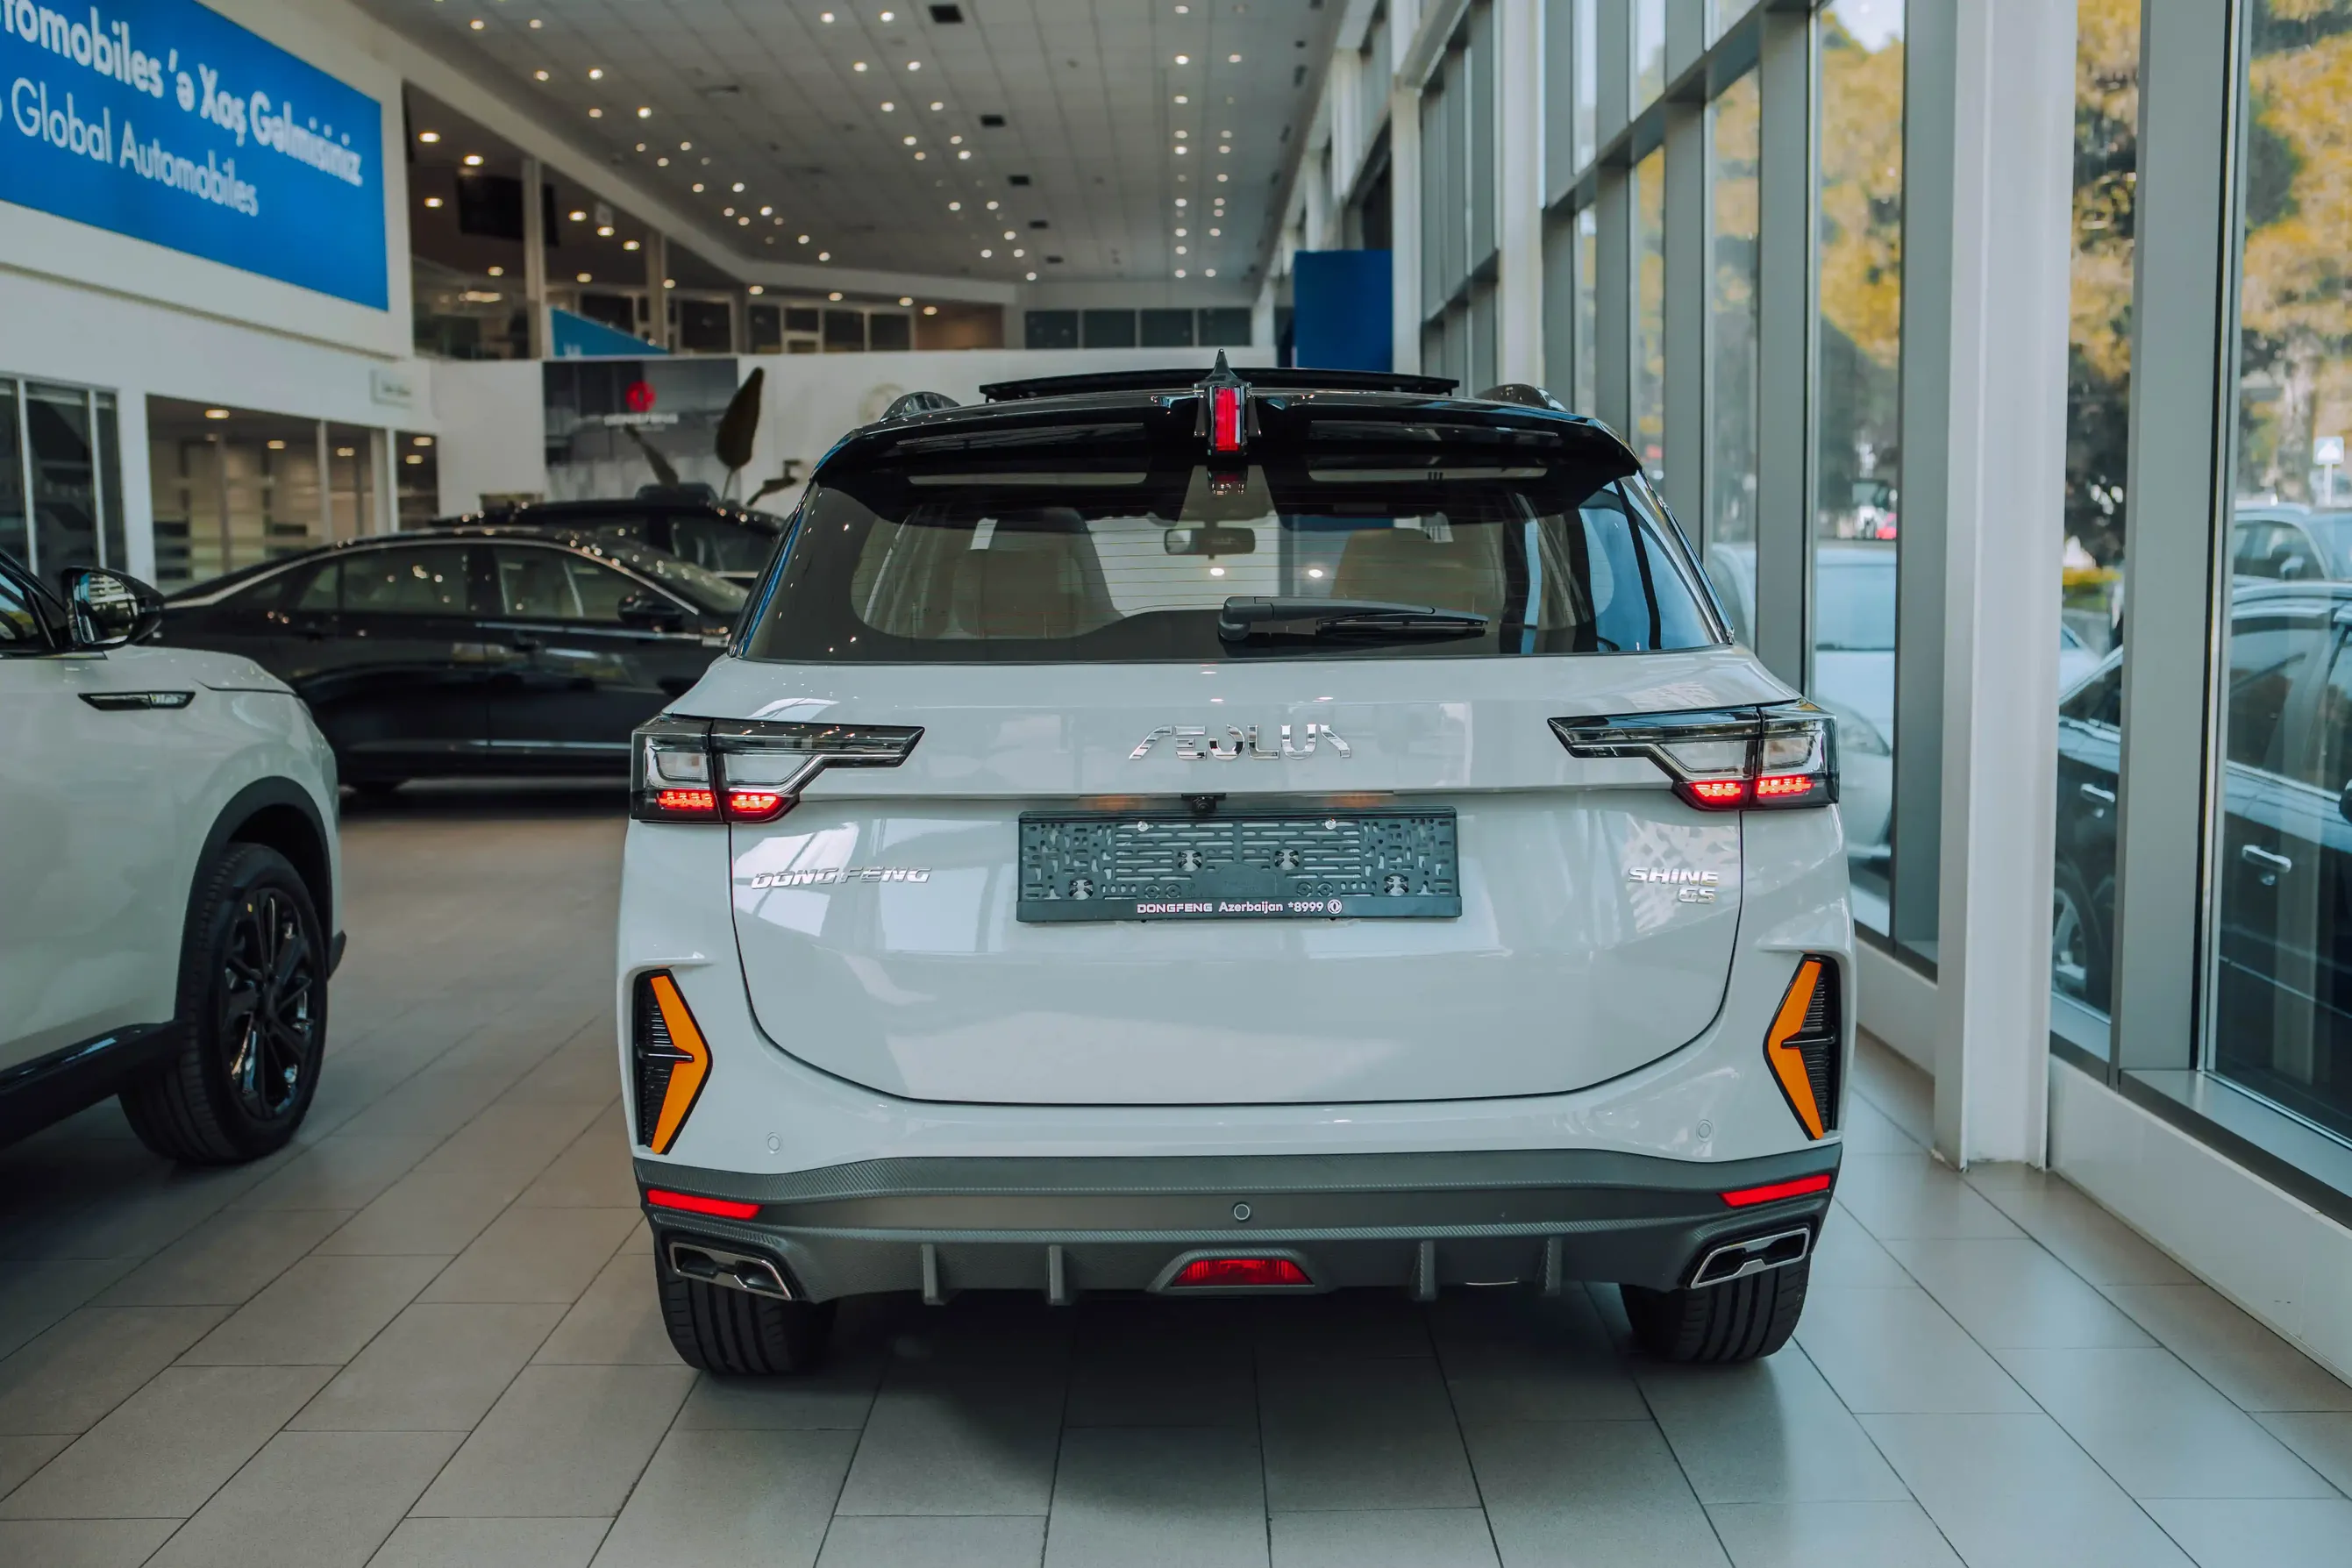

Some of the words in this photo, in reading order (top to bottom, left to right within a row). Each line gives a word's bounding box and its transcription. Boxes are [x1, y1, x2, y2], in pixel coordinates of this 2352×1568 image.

[0, 0, 164, 98] tomobiles
[11, 77, 112, 164] Global
[119, 120, 259, 217] Automobiles
[751, 866, 932, 889] DONGFENG
[1628, 866, 1719, 887] SHINE
[1678, 887, 1716, 904] GS
[1137, 902, 1213, 914] DONGFENG
[1218, 901, 1283, 915] Azerbaijan
